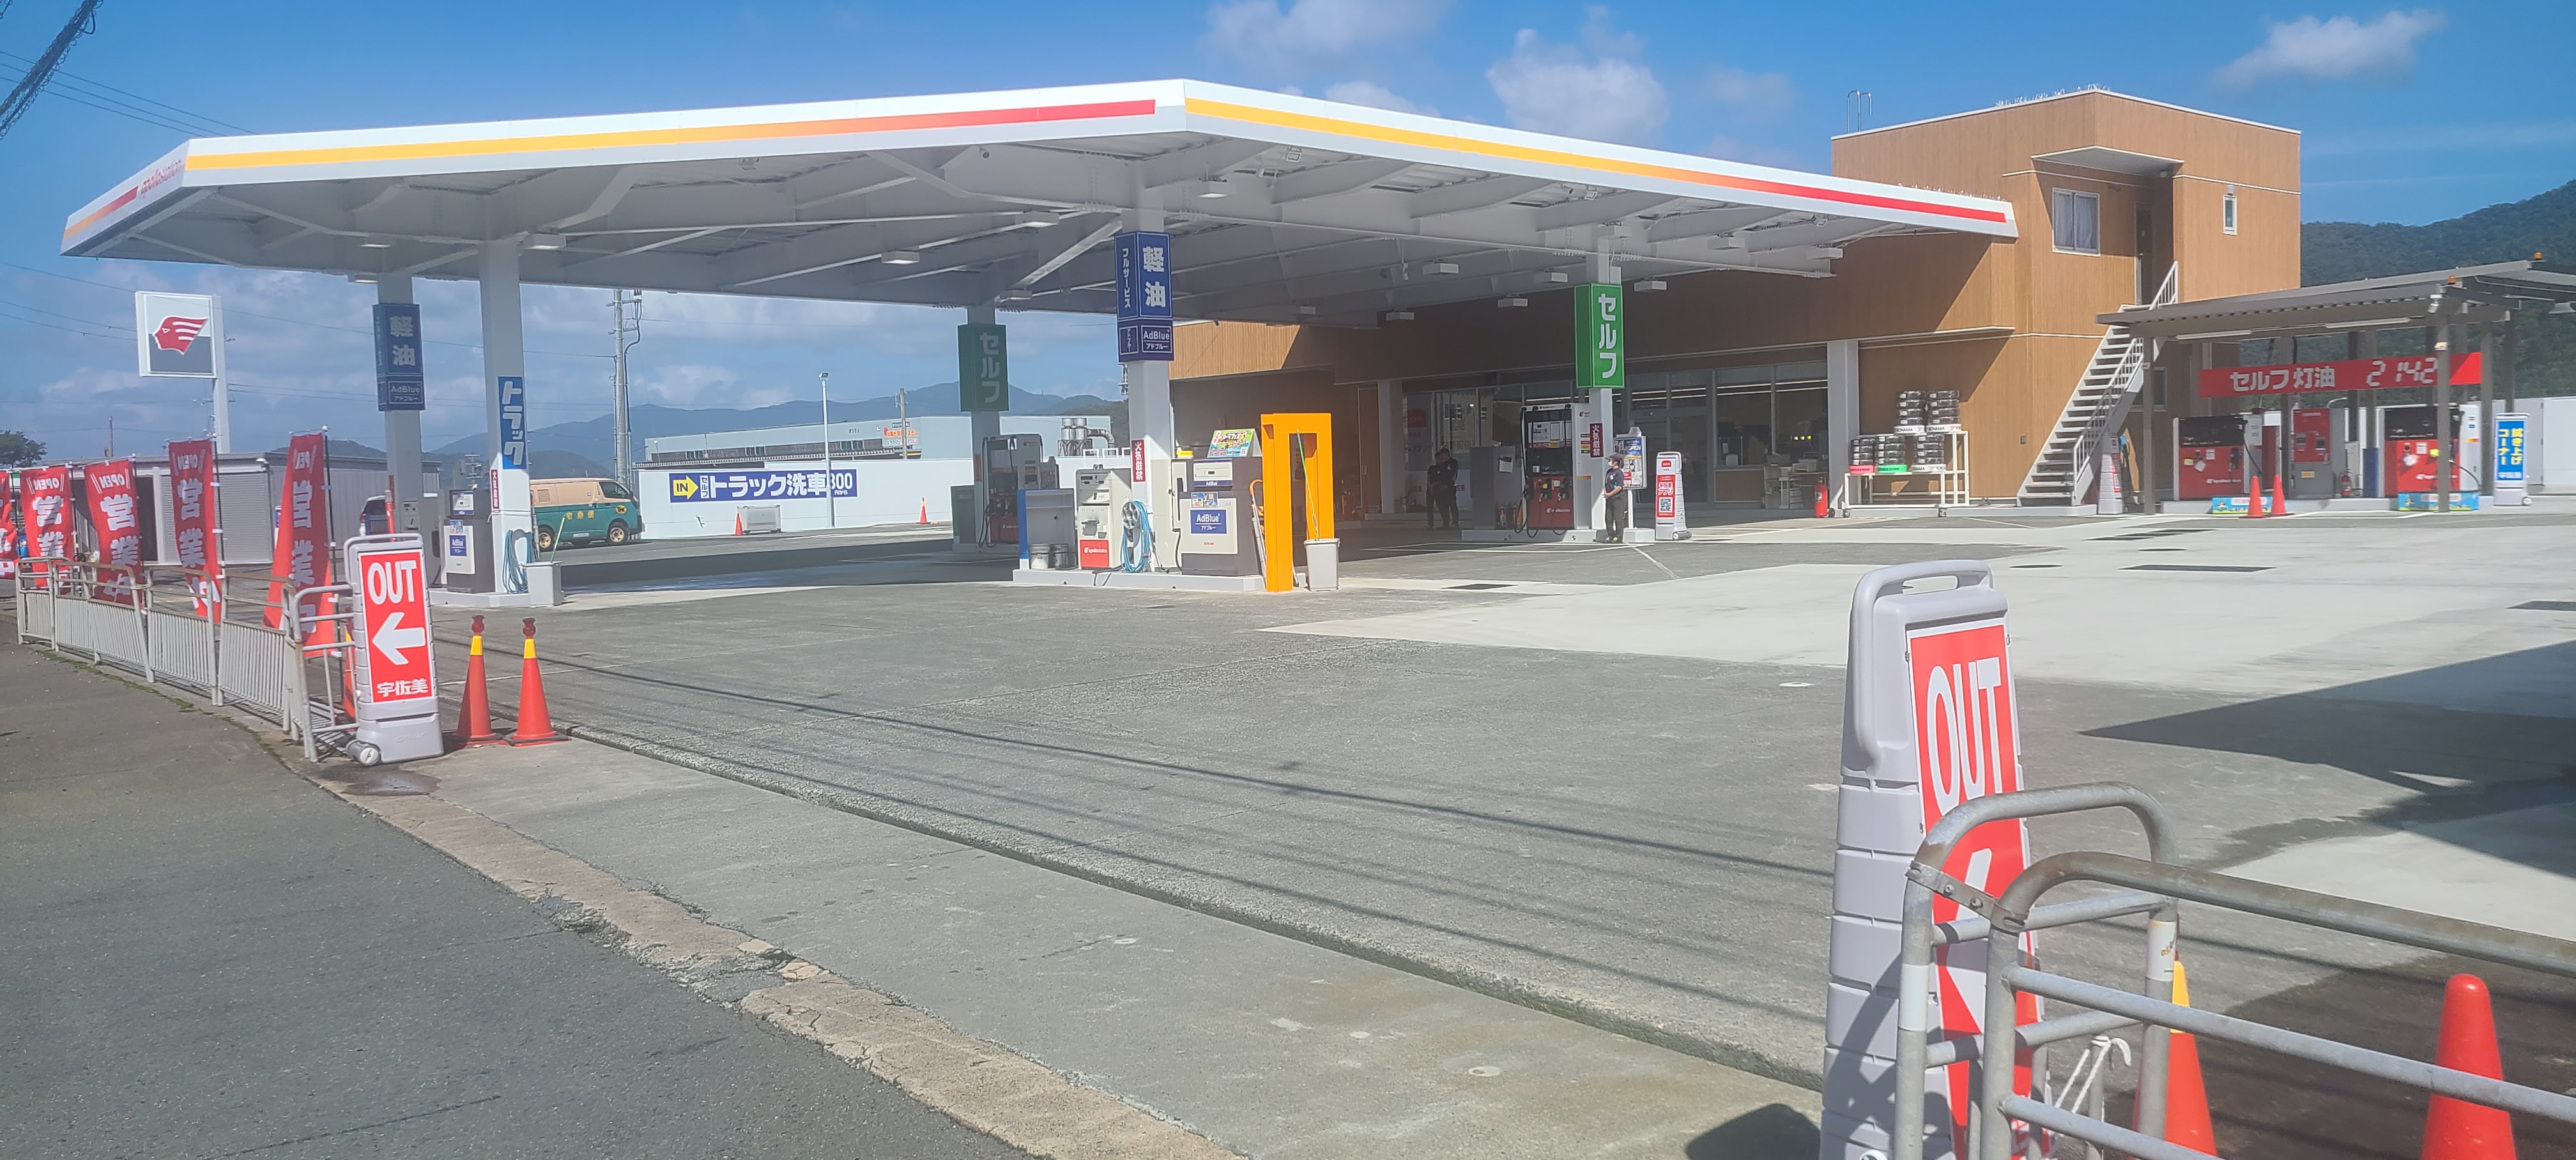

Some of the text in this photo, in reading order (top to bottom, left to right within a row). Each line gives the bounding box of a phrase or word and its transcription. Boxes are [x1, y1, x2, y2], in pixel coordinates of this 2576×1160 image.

[1122, 247, 1131, 309] フルサービス
[1142, 246, 1166, 308] 軽油
[390, 315, 415, 366] 軽油
[1143, 330, 1170, 340] AdBlue
[1598, 293, 1617, 379] セルフ
[979, 332, 1000, 404] セルフ
[502, 381, 525, 466] トラック
[2498, 429, 2510, 465] コーナー
[676, 482, 689, 492] IN
[710, 473, 827, 498] トラック洗車
[1196, 514, 1220, 523] AdBlue
[367, 560, 417, 605] OUT
[377, 678, 429, 698] 宇佐美
[1926, 657, 2002, 816] OUT
